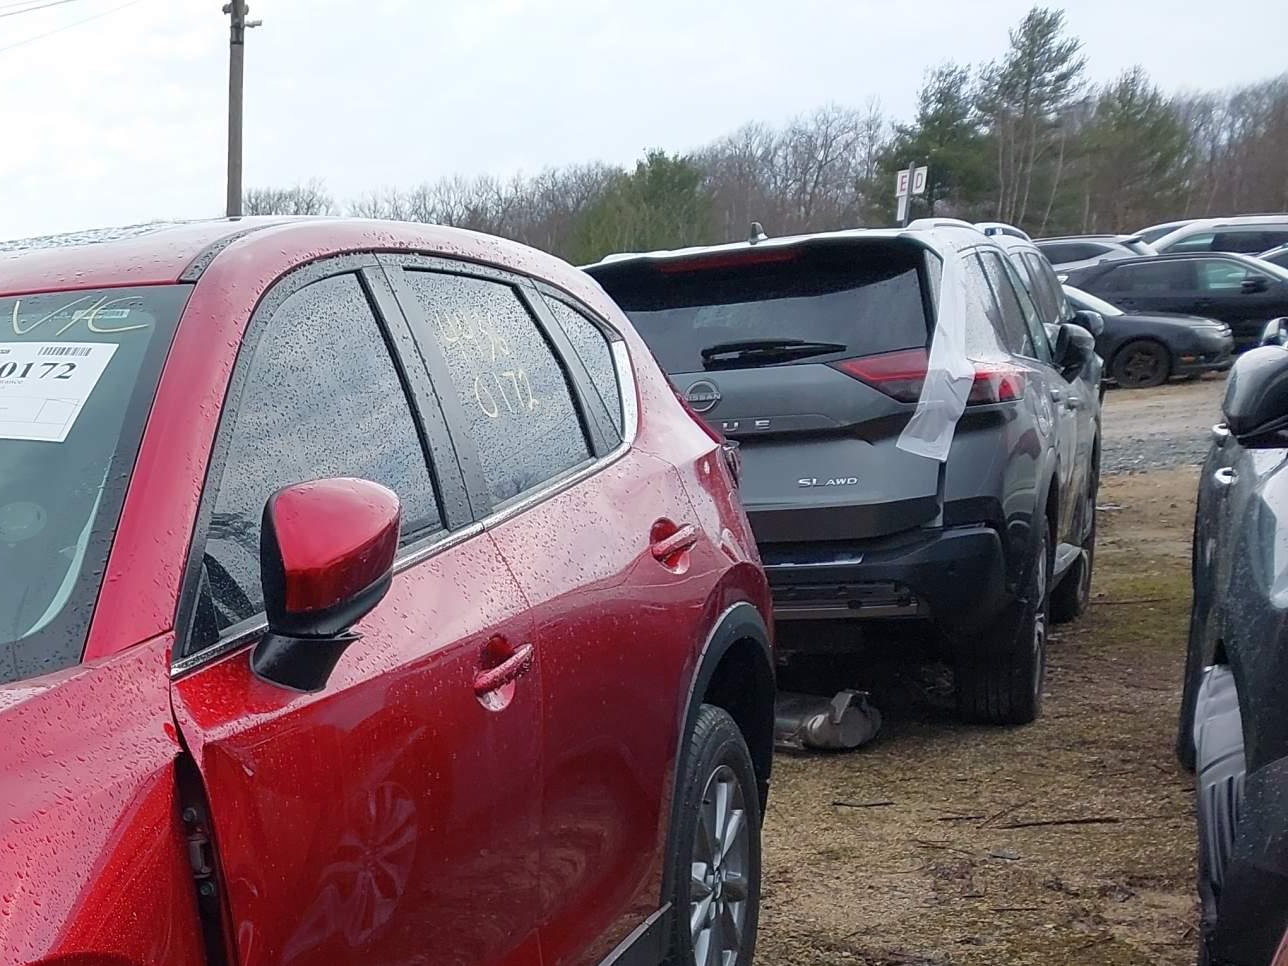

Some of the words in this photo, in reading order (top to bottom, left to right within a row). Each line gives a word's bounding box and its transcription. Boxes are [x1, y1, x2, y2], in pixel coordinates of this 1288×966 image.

[900, 174, 908, 192] E
[915, 172, 923, 189] D
[798, 478, 824, 487] SL
[825, 477, 858, 486] AWD
